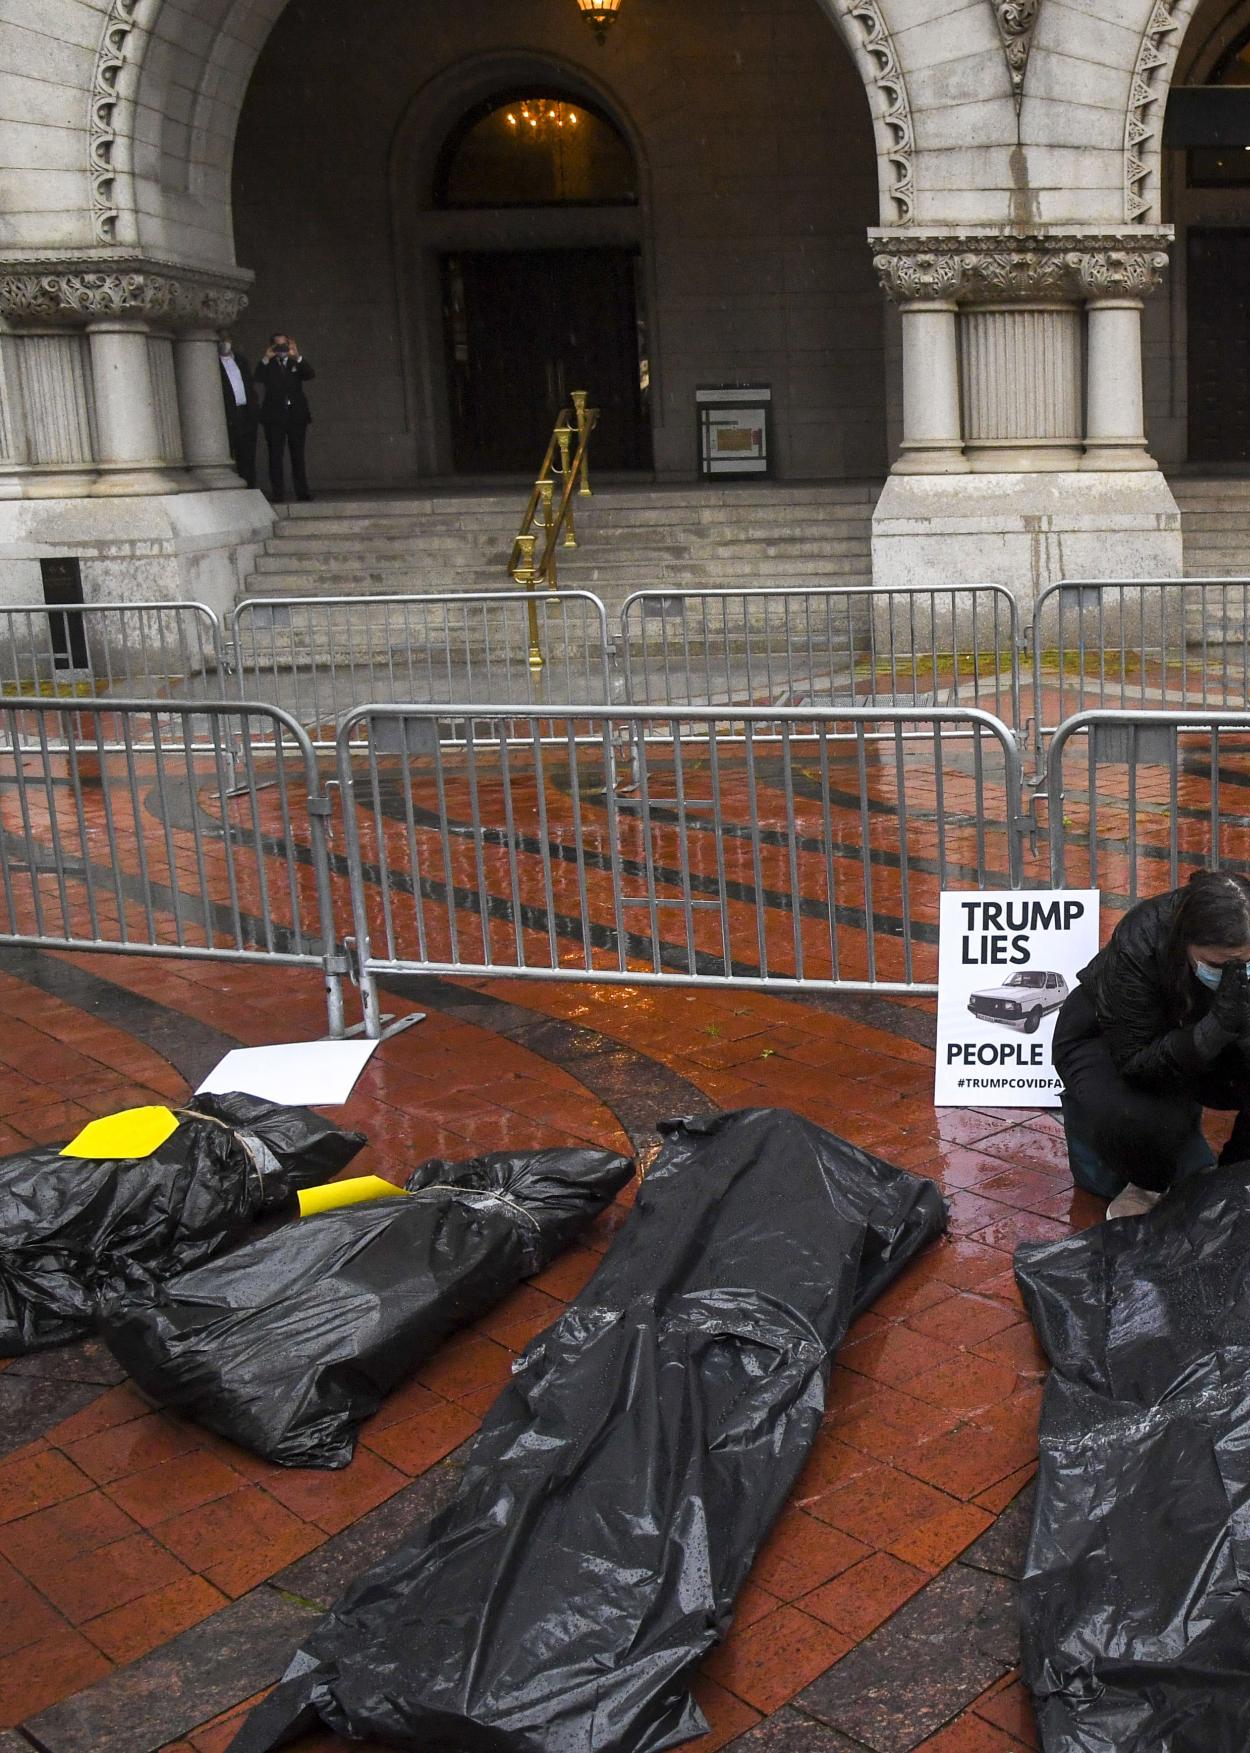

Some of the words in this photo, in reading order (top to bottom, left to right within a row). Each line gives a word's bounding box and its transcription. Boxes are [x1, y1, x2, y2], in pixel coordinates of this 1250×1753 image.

[961, 900, 1085, 932] TRUMP
[961, 934, 1031, 965] LIES
[946, 1042, 1044, 1066] PEOPLE
[957, 1077, 1066, 1089] #TRUMPCOVIDFA
